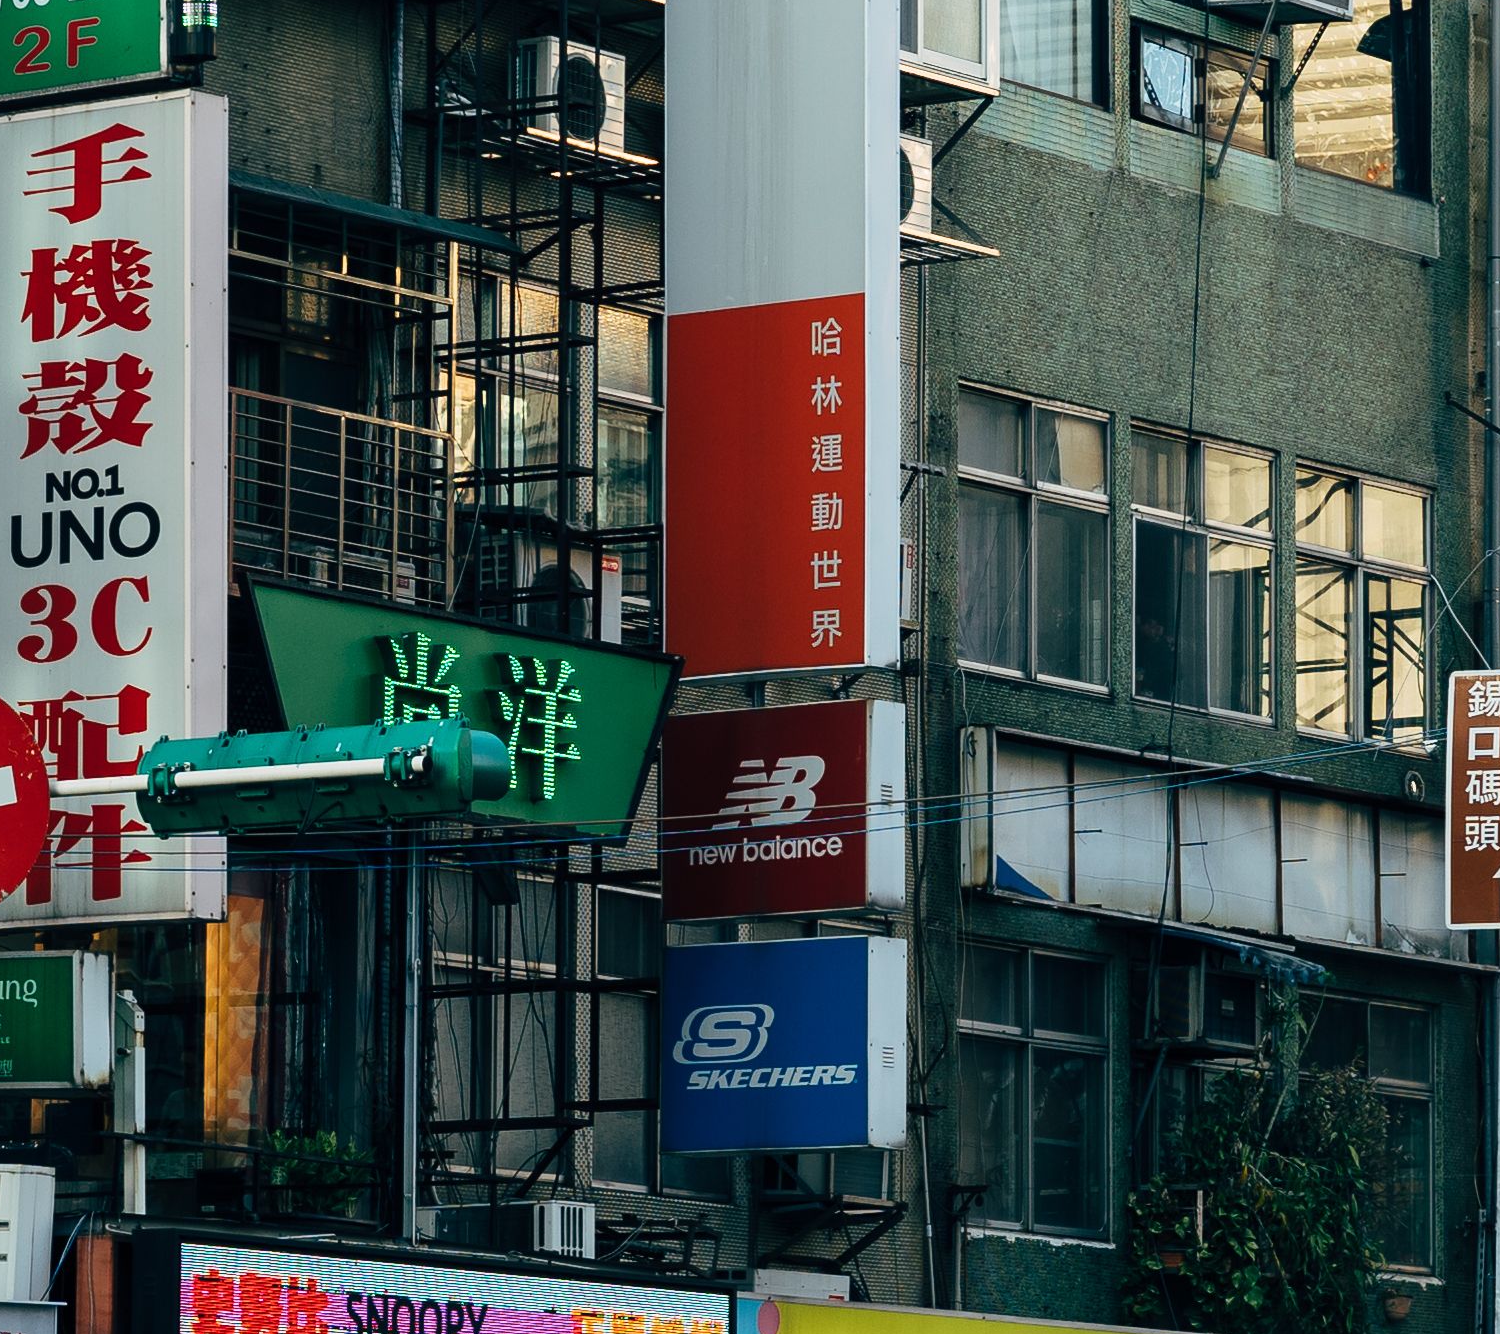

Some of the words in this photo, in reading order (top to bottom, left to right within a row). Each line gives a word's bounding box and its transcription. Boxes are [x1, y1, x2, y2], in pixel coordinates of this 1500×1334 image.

[11, 15, 102, 75] 2F
[18, 122, 154, 461] 手機殼
[43, 468, 126, 501] NO.1
[809, 316, 843, 649] 哈林運動世界
[10, 499, 162, 569] UNO
[17, 575, 153, 663] 3C
[383, 630, 582, 801] 尚洋
[18, 683, 153, 906] 配件
[688, 840, 736, 867] new
[742, 834, 843, 863] balance
[686, 1064, 860, 1091] SKECHERS
